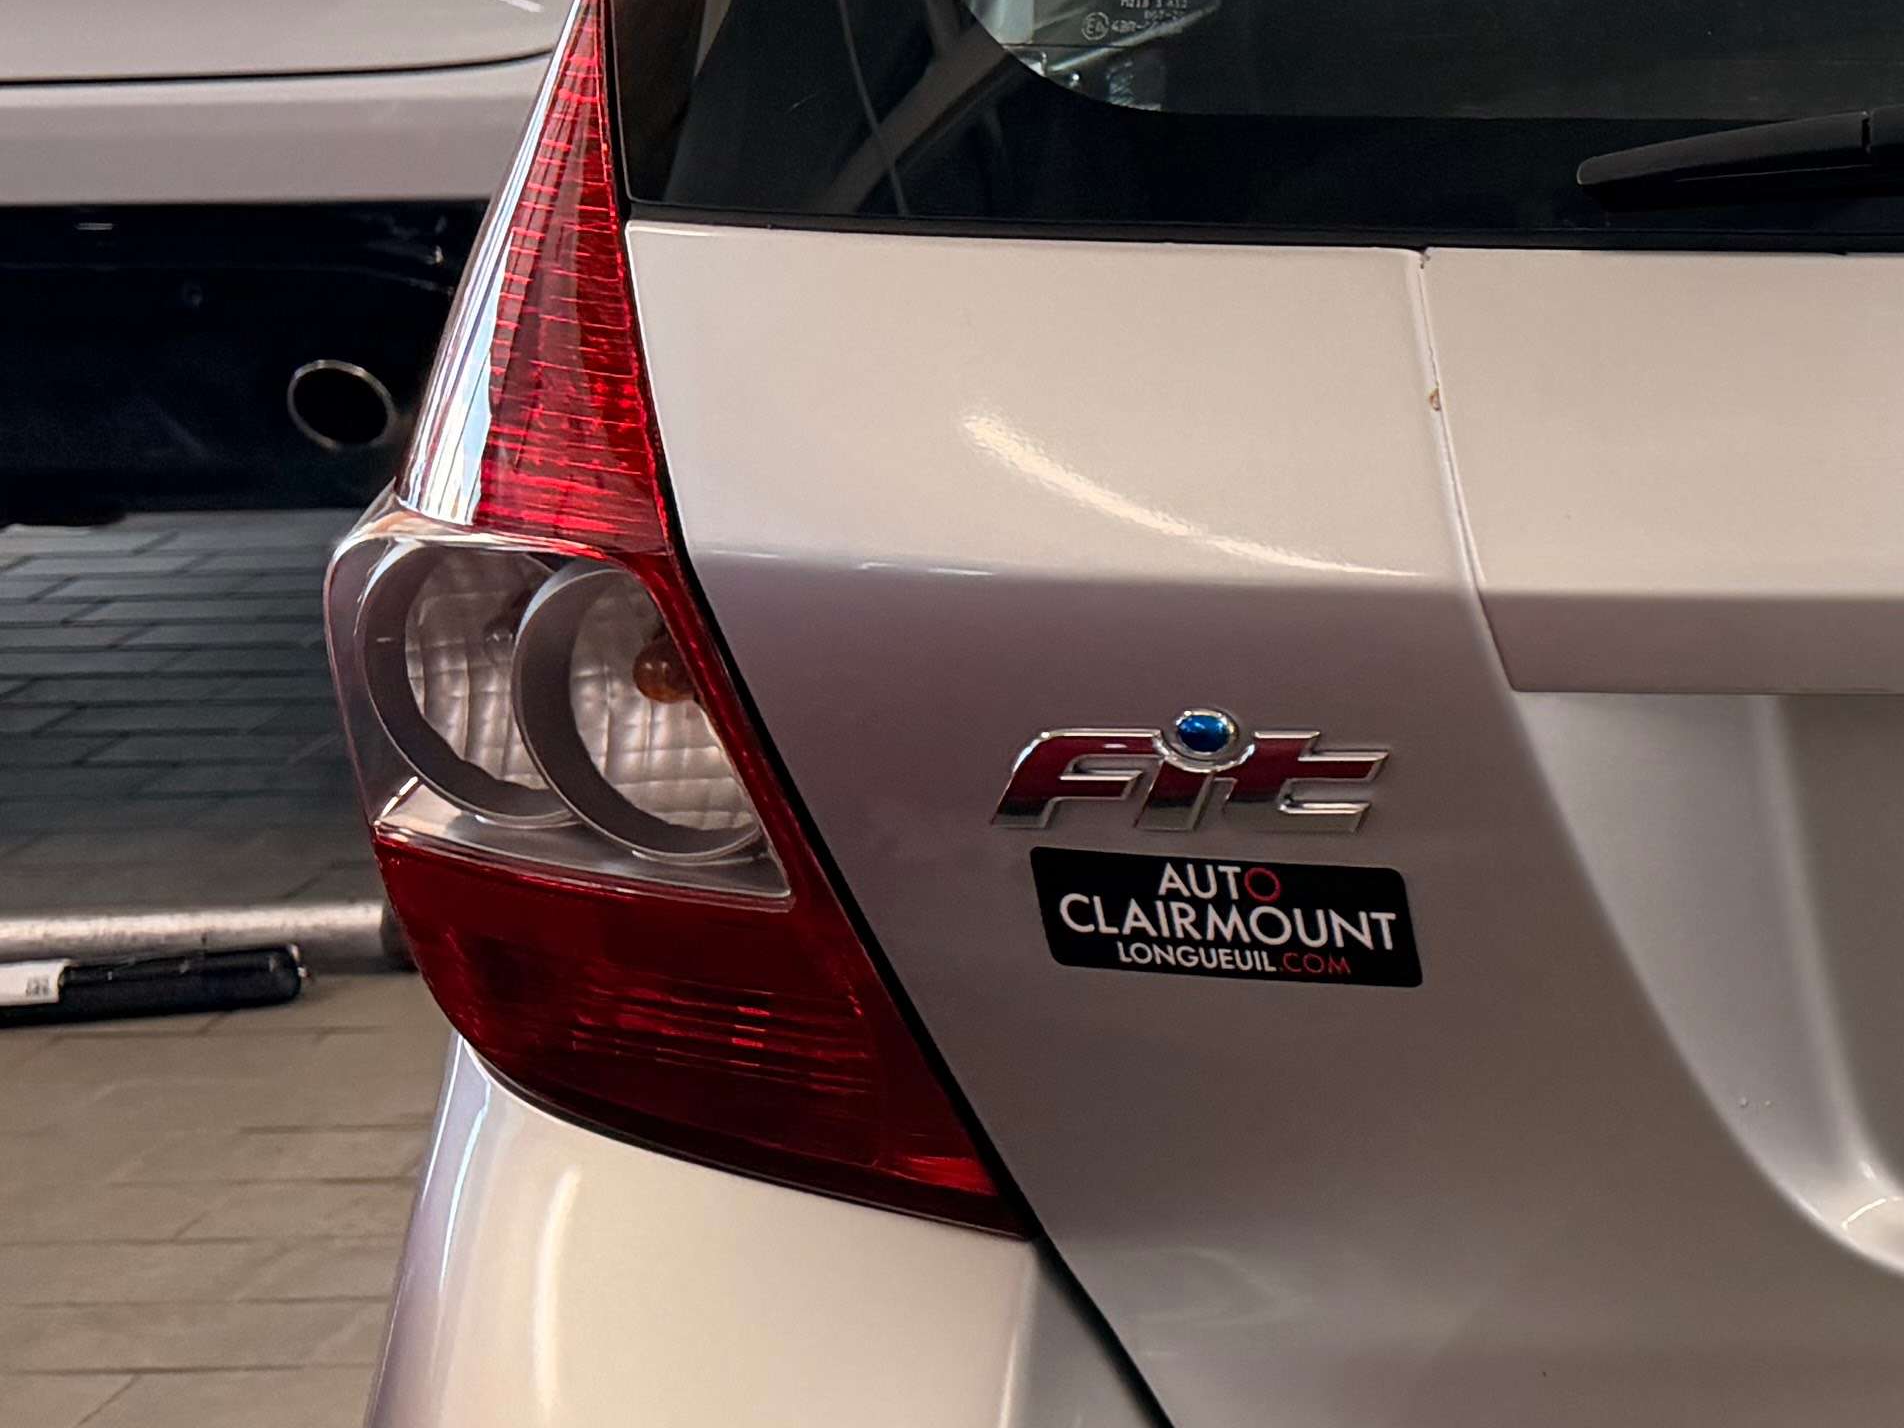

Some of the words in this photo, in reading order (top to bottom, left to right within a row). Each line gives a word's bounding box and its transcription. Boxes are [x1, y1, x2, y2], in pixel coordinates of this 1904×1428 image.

[1158, 863, 1281, 904] AUTO
[1059, 893, 1397, 953] CLAIRMOUNT
[1118, 940, 1352, 976] LONGUEUIL.COM
